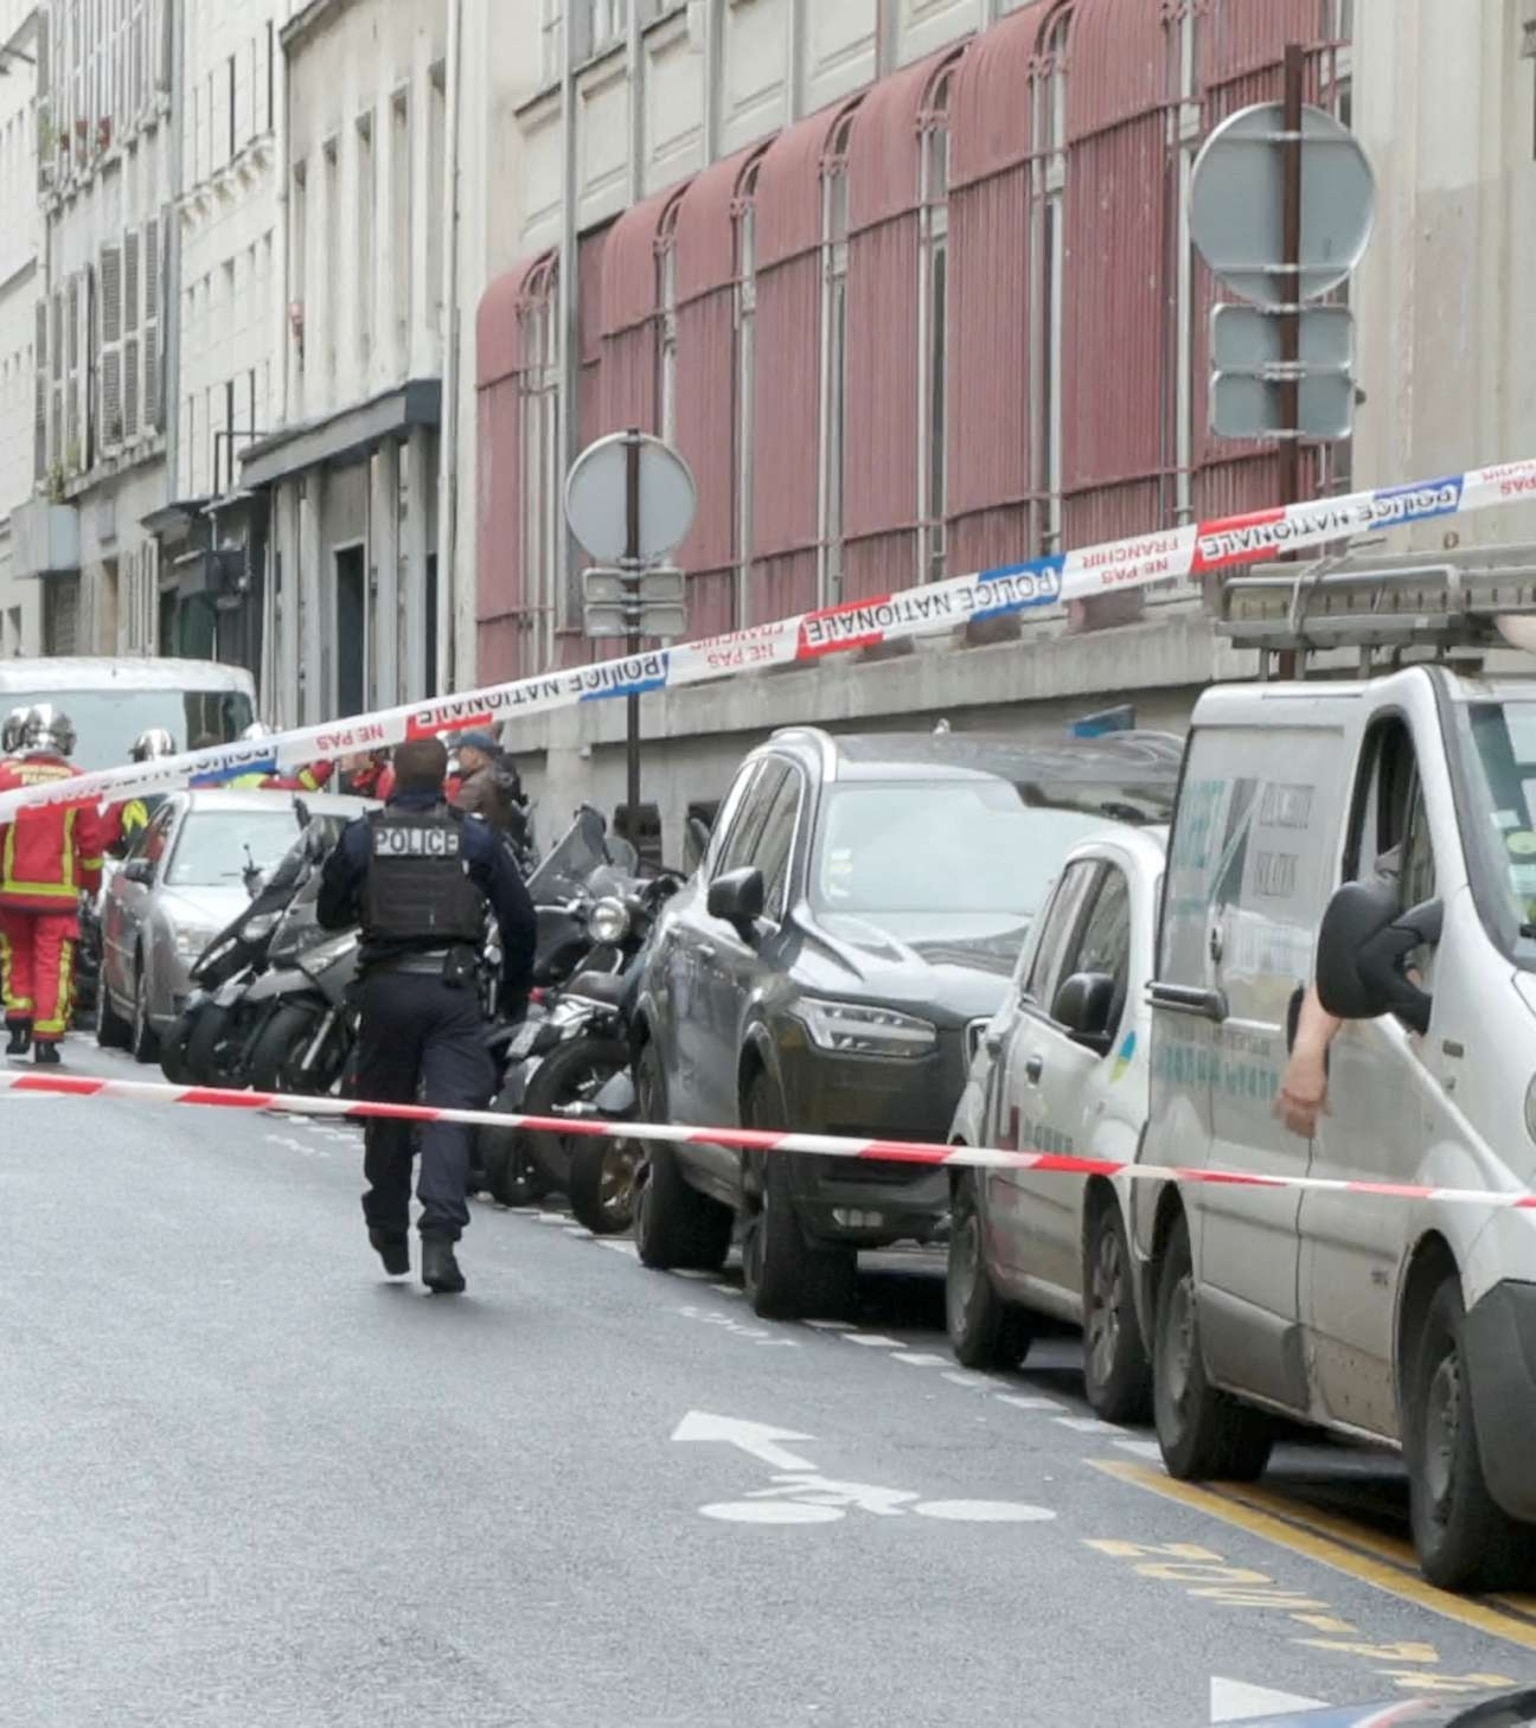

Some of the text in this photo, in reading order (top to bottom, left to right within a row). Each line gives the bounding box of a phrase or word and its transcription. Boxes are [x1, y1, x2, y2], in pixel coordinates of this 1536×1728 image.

[1082, 537, 1179, 568] FRANCHIR
[1101, 559, 1169, 585] NE PAS
[808, 567, 1056, 642] POLICE NATIONALE
[707, 643, 774, 667] NE PAS
[569, 655, 661, 692] POLICE
[315, 722, 384, 751] NE PAS
[376, 827, 460, 856] POLICE
